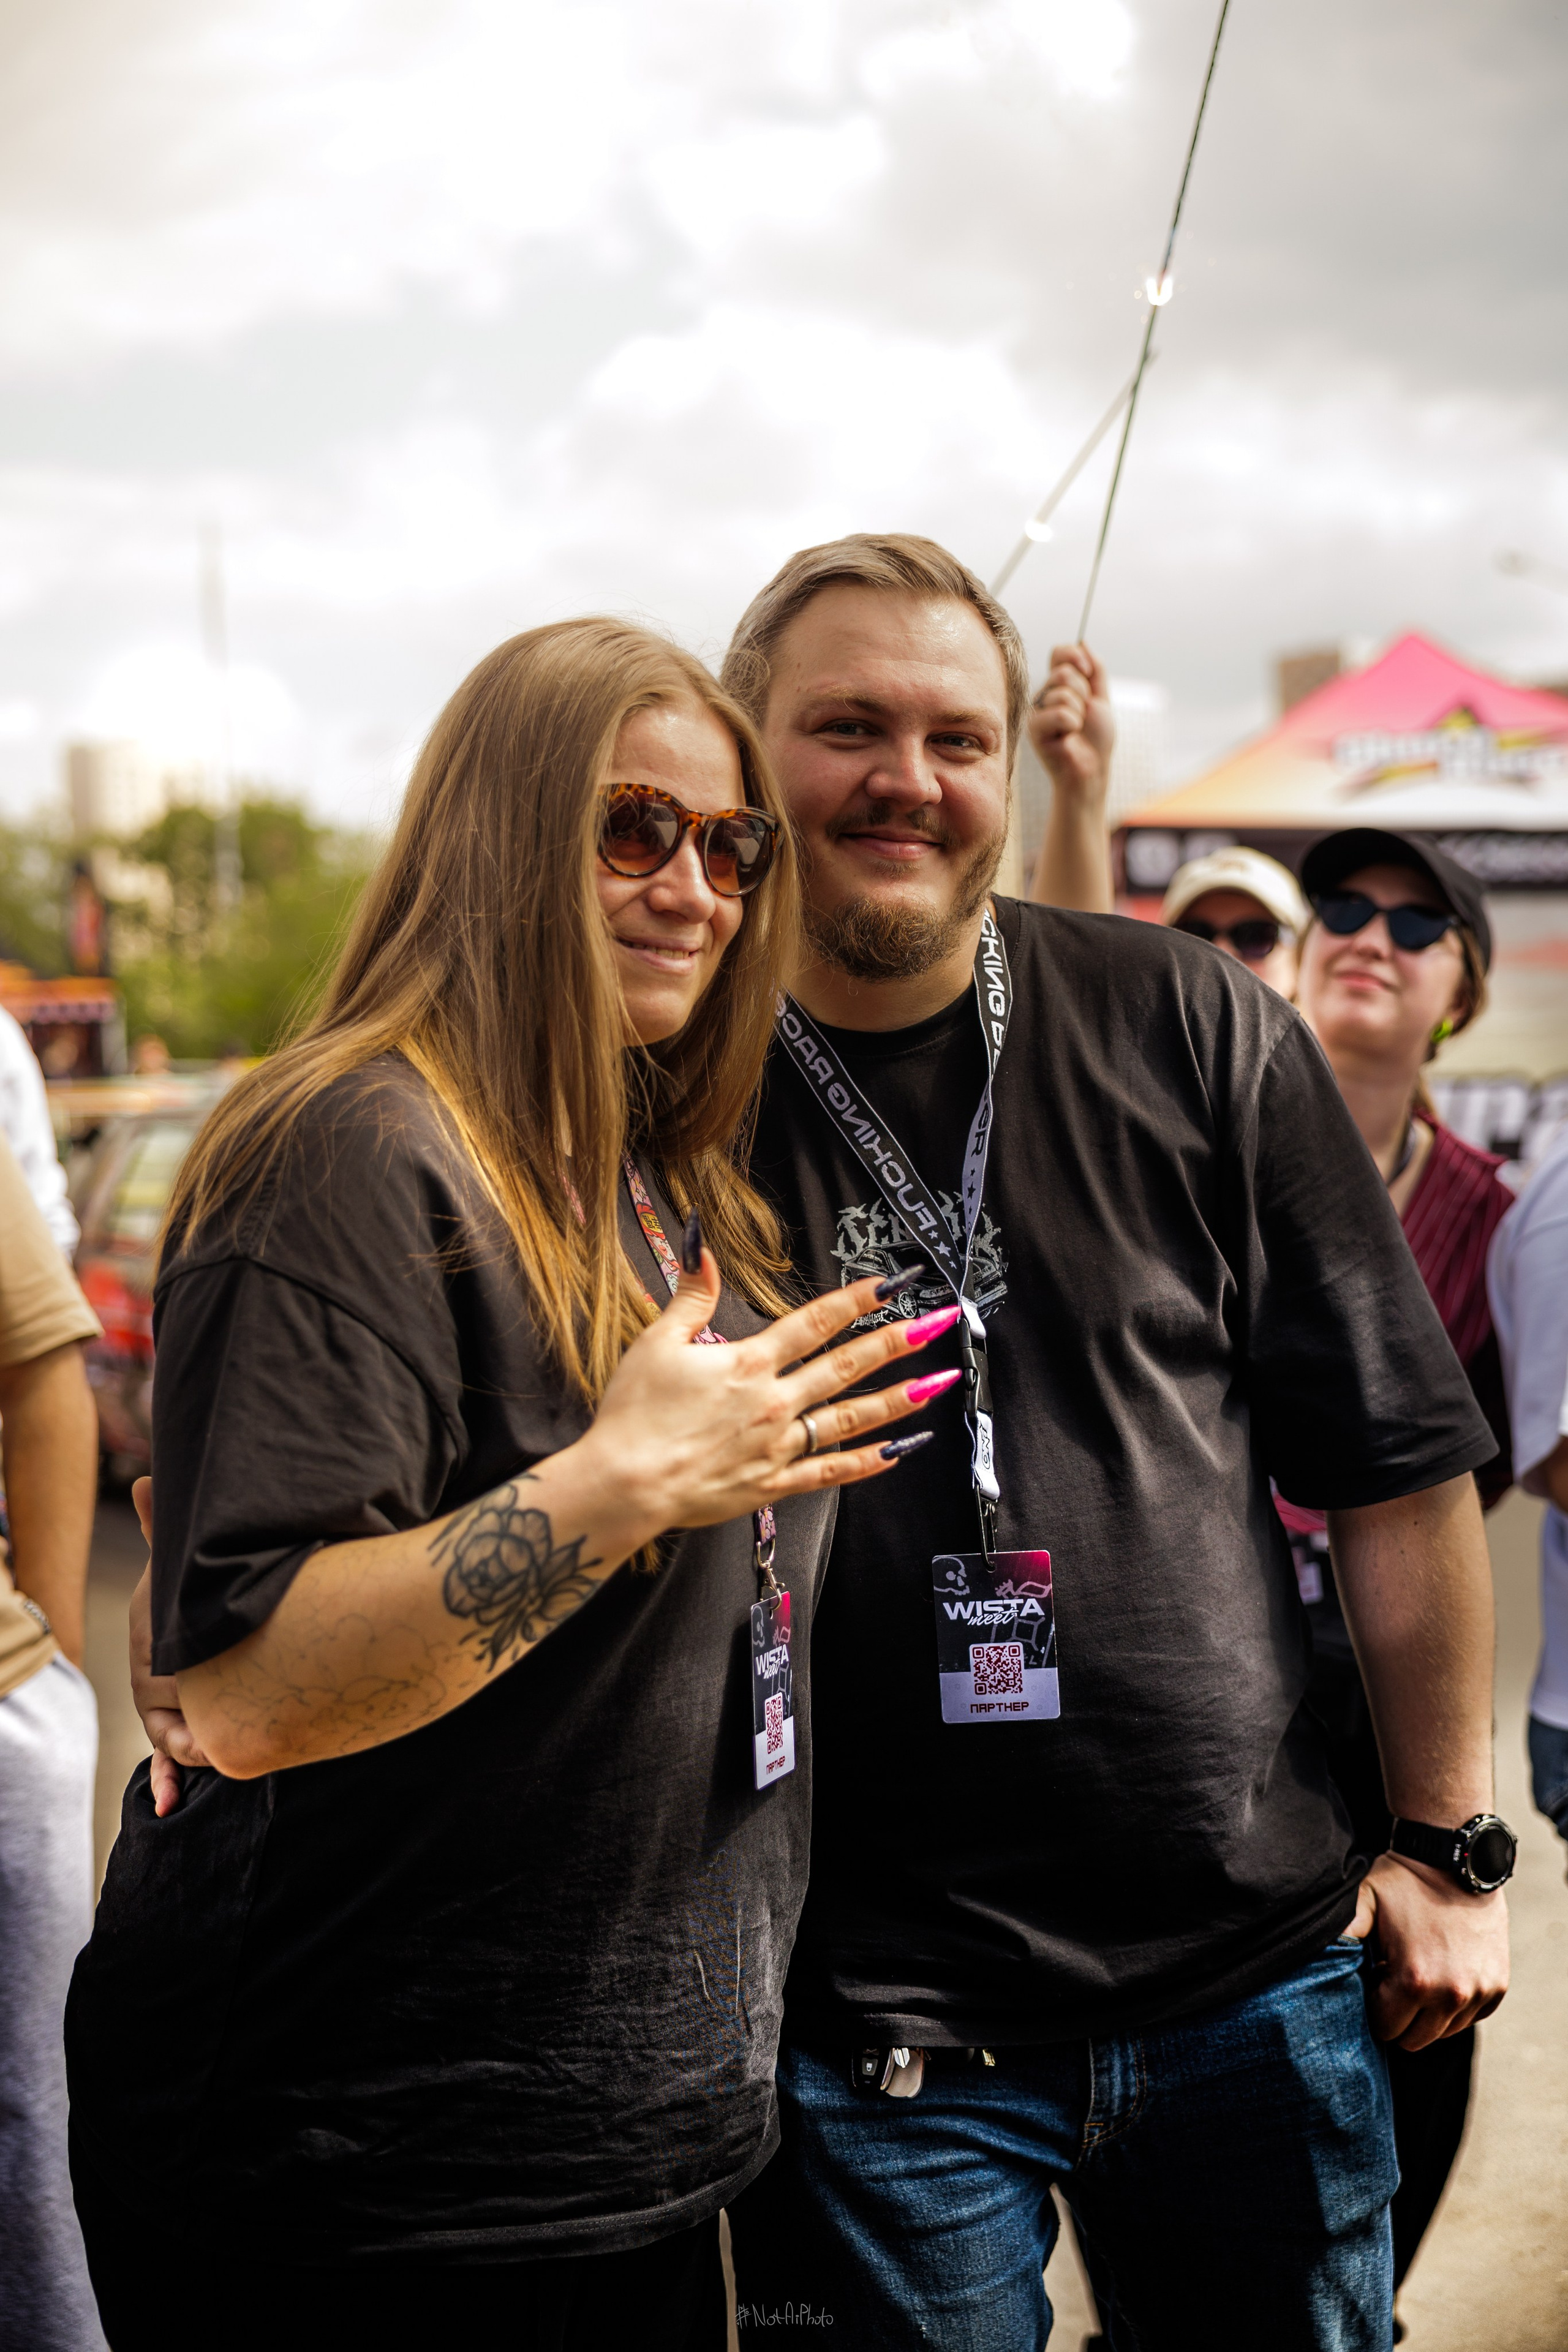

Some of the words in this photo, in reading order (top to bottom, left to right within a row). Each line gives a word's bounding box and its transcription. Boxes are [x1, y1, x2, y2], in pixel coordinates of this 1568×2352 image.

[943, 1598, 1045, 1621] WISTA
[967, 1607, 1019, 1626] meet
[755, 1644, 789, 1675] WISTA
[970, 1702, 1029, 1714] ПАРТНЕР
